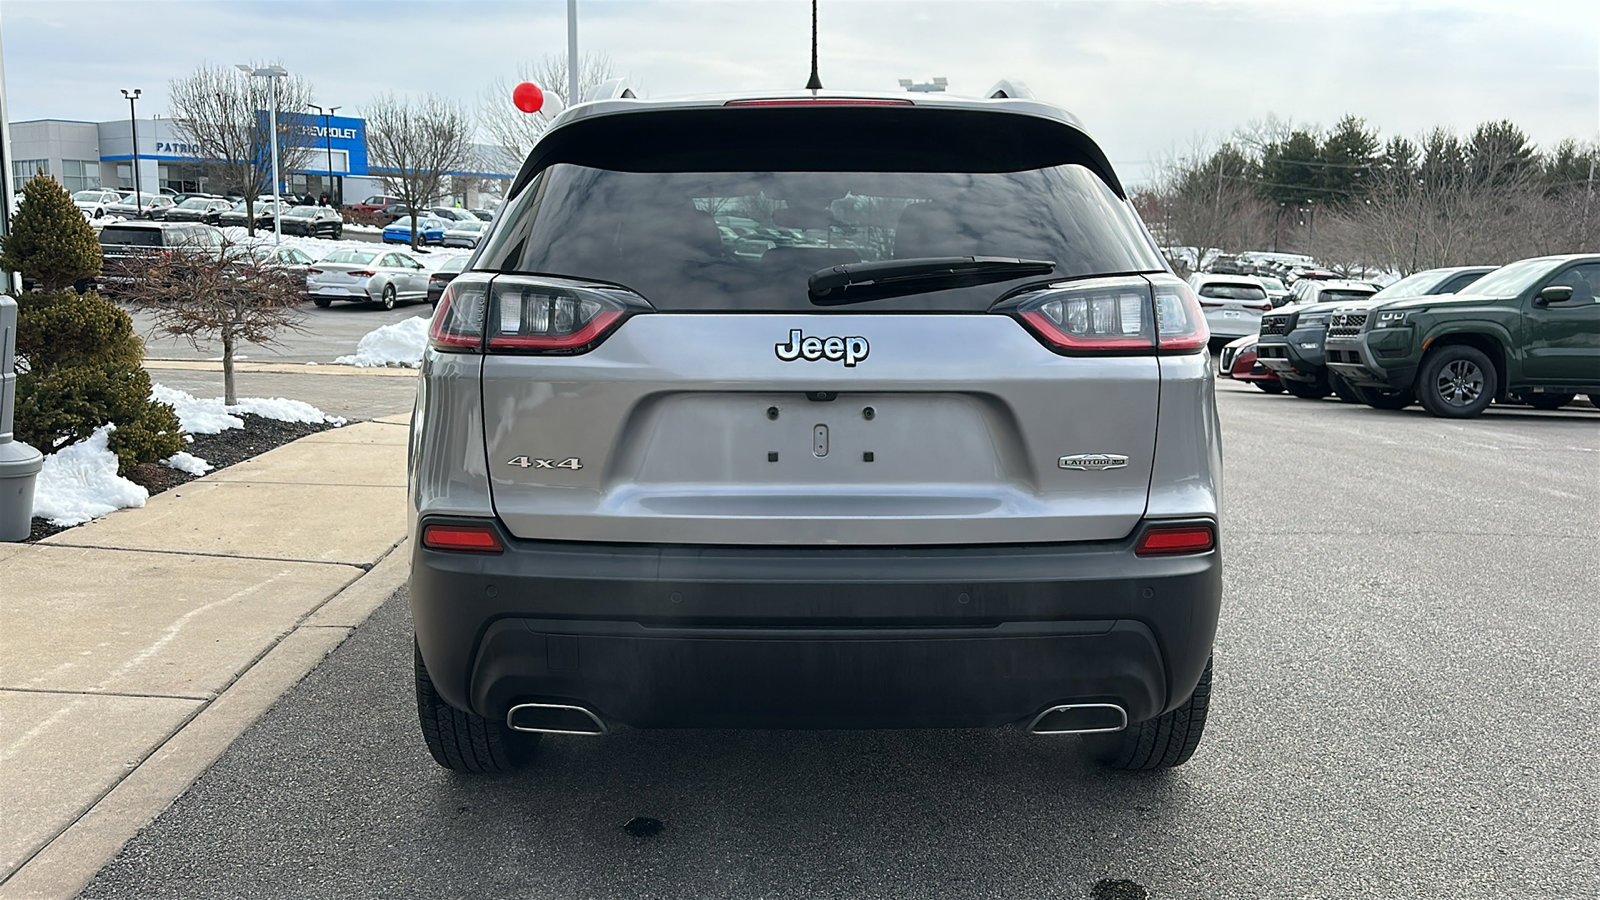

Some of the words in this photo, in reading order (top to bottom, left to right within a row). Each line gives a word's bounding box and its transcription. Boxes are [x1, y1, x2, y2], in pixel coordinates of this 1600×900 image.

[156, 142, 206, 154] PATRIO
[775, 328, 870, 367] Jeep
[507, 455, 584, 470] 4x4
